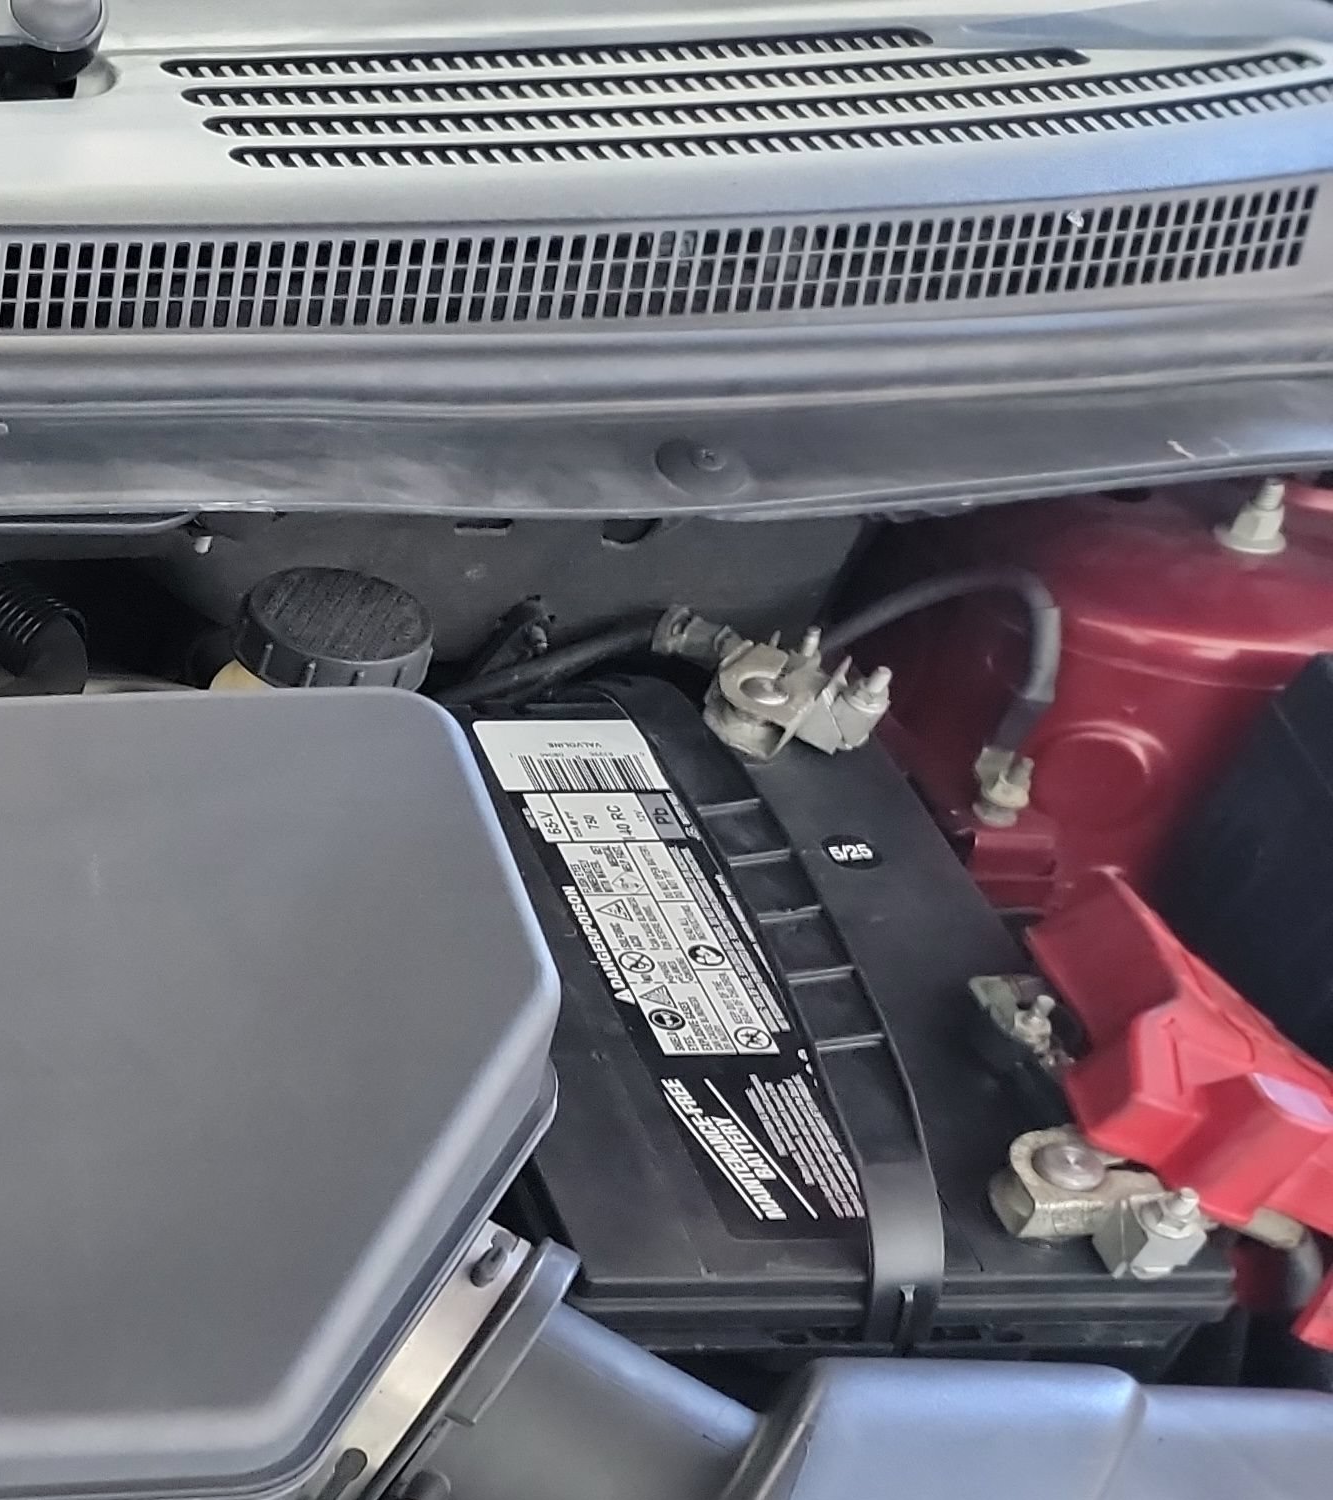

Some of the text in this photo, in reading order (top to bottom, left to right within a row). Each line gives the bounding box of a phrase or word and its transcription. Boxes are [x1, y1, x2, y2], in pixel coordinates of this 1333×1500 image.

[537, 811, 562, 835] 65-V
[583, 815, 600, 829] 750
[606, 805, 626, 821] RC
[652, 807, 674, 825] Pb
[661, 1078, 787, 1220] MAINTENANCE-FREE
[711, 1116, 777, 1180] BATTERY
